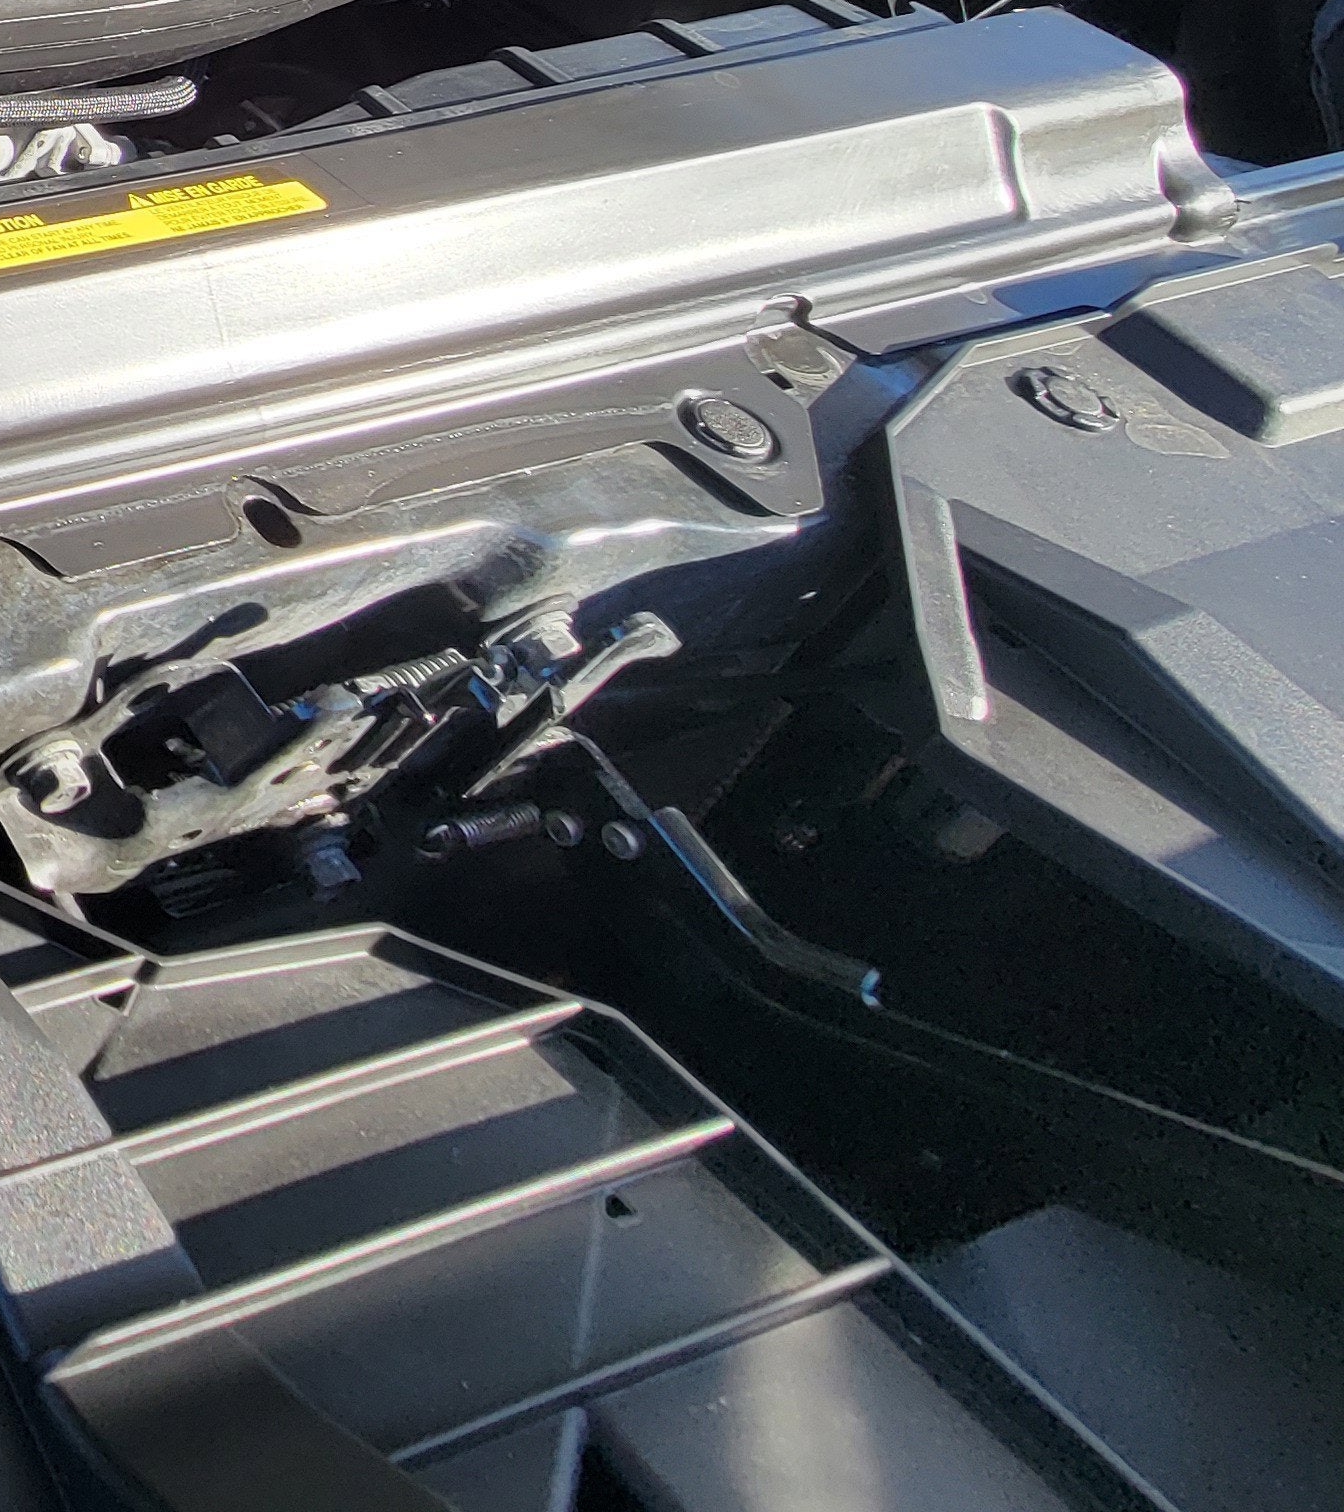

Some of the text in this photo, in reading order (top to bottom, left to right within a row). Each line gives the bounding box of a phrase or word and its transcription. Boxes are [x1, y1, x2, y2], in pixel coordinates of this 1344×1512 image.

[146, 175, 264, 205] MISE EN GARDE
[7, 234, 30, 244] CAN
[29, 228, 61, 240] START
[74, 222, 94, 232] ANY
[45, 243, 67, 252] FAN
[80, 236, 101, 246] ALL
